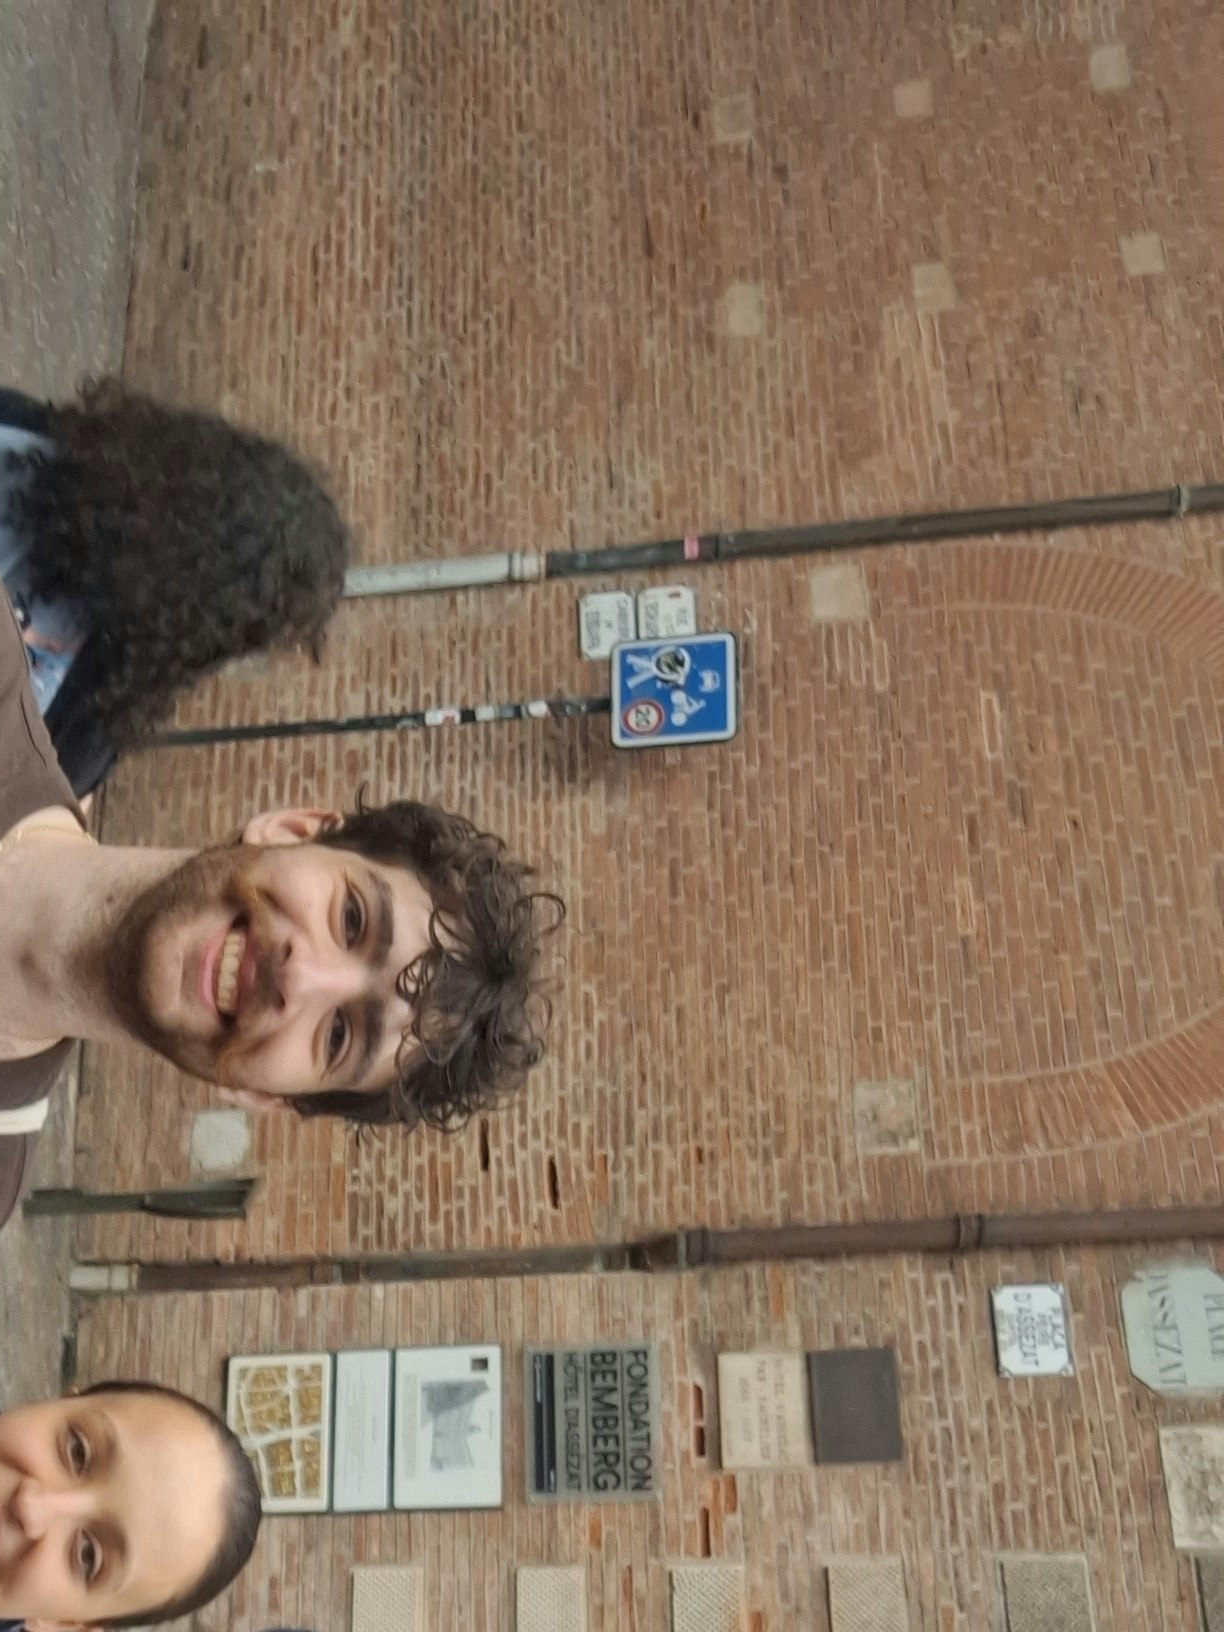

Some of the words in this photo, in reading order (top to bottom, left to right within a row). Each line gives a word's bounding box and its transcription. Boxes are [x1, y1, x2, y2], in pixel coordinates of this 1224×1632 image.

[563, 1353, 583, 1402] HÔTEL
[590, 1352, 621, 1491] BEMBERG
[627, 1350, 652, 1491] FONDATION
